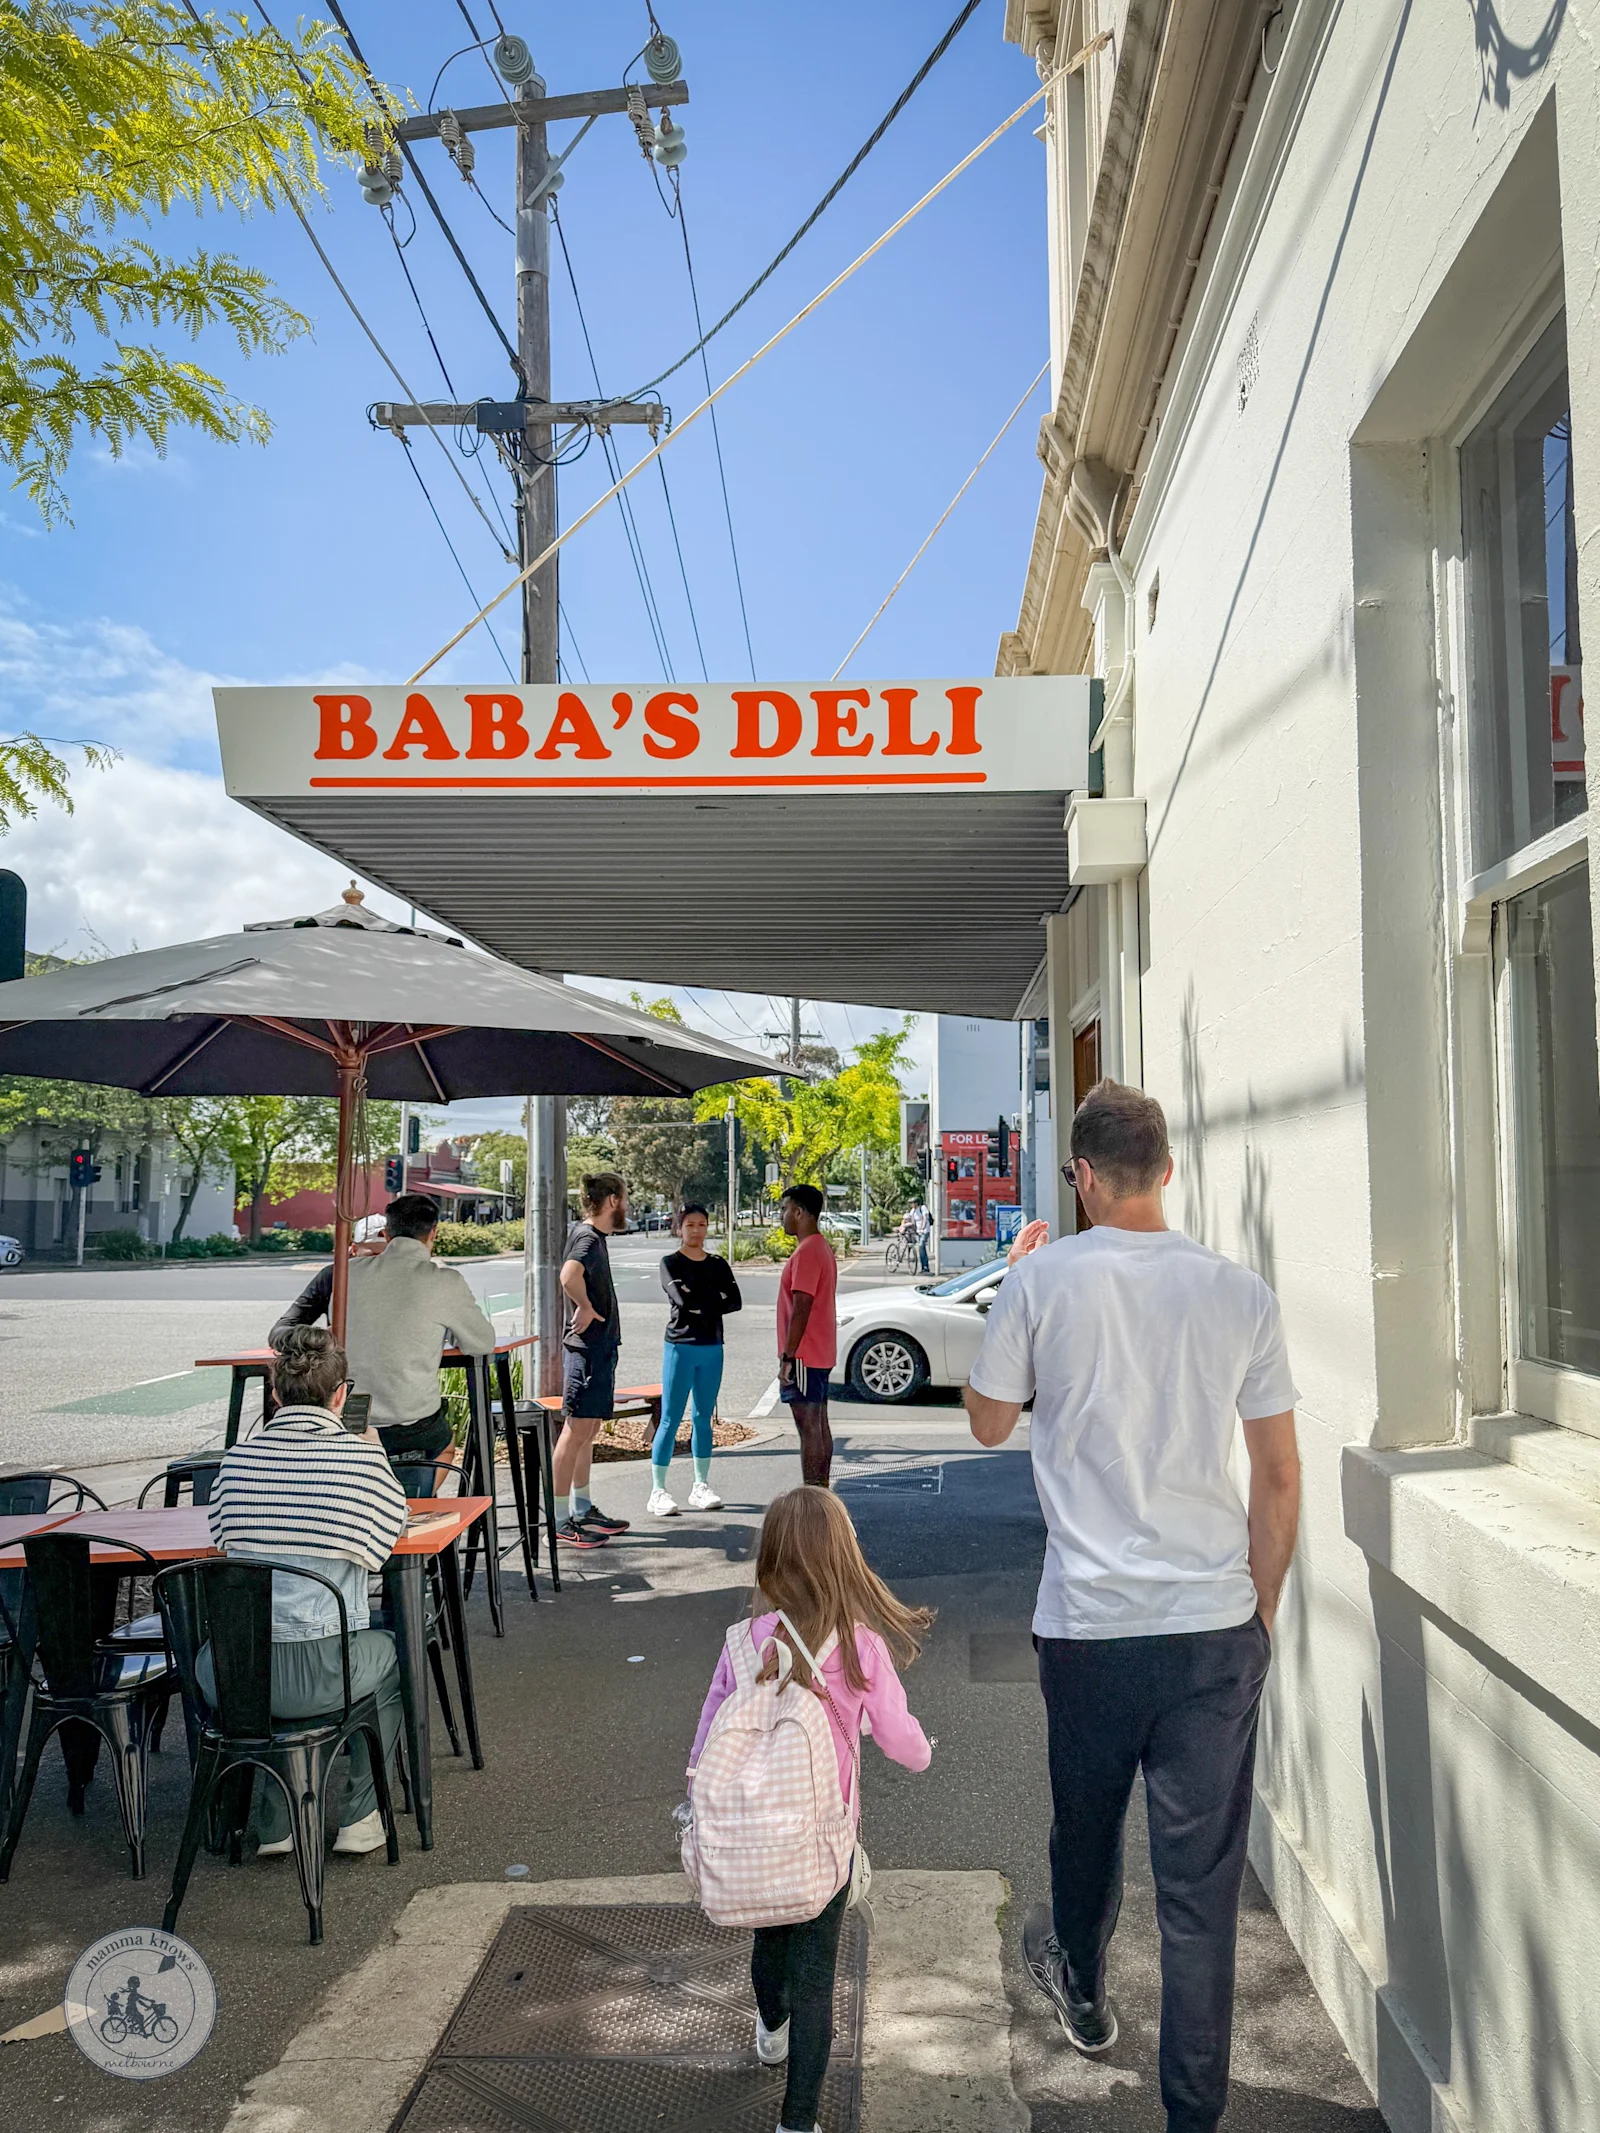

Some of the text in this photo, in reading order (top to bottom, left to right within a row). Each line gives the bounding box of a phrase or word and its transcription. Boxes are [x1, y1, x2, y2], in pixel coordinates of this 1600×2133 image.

[314, 687, 982, 760] BABA’S DELI
[949, 1133, 974, 1145] FOR
